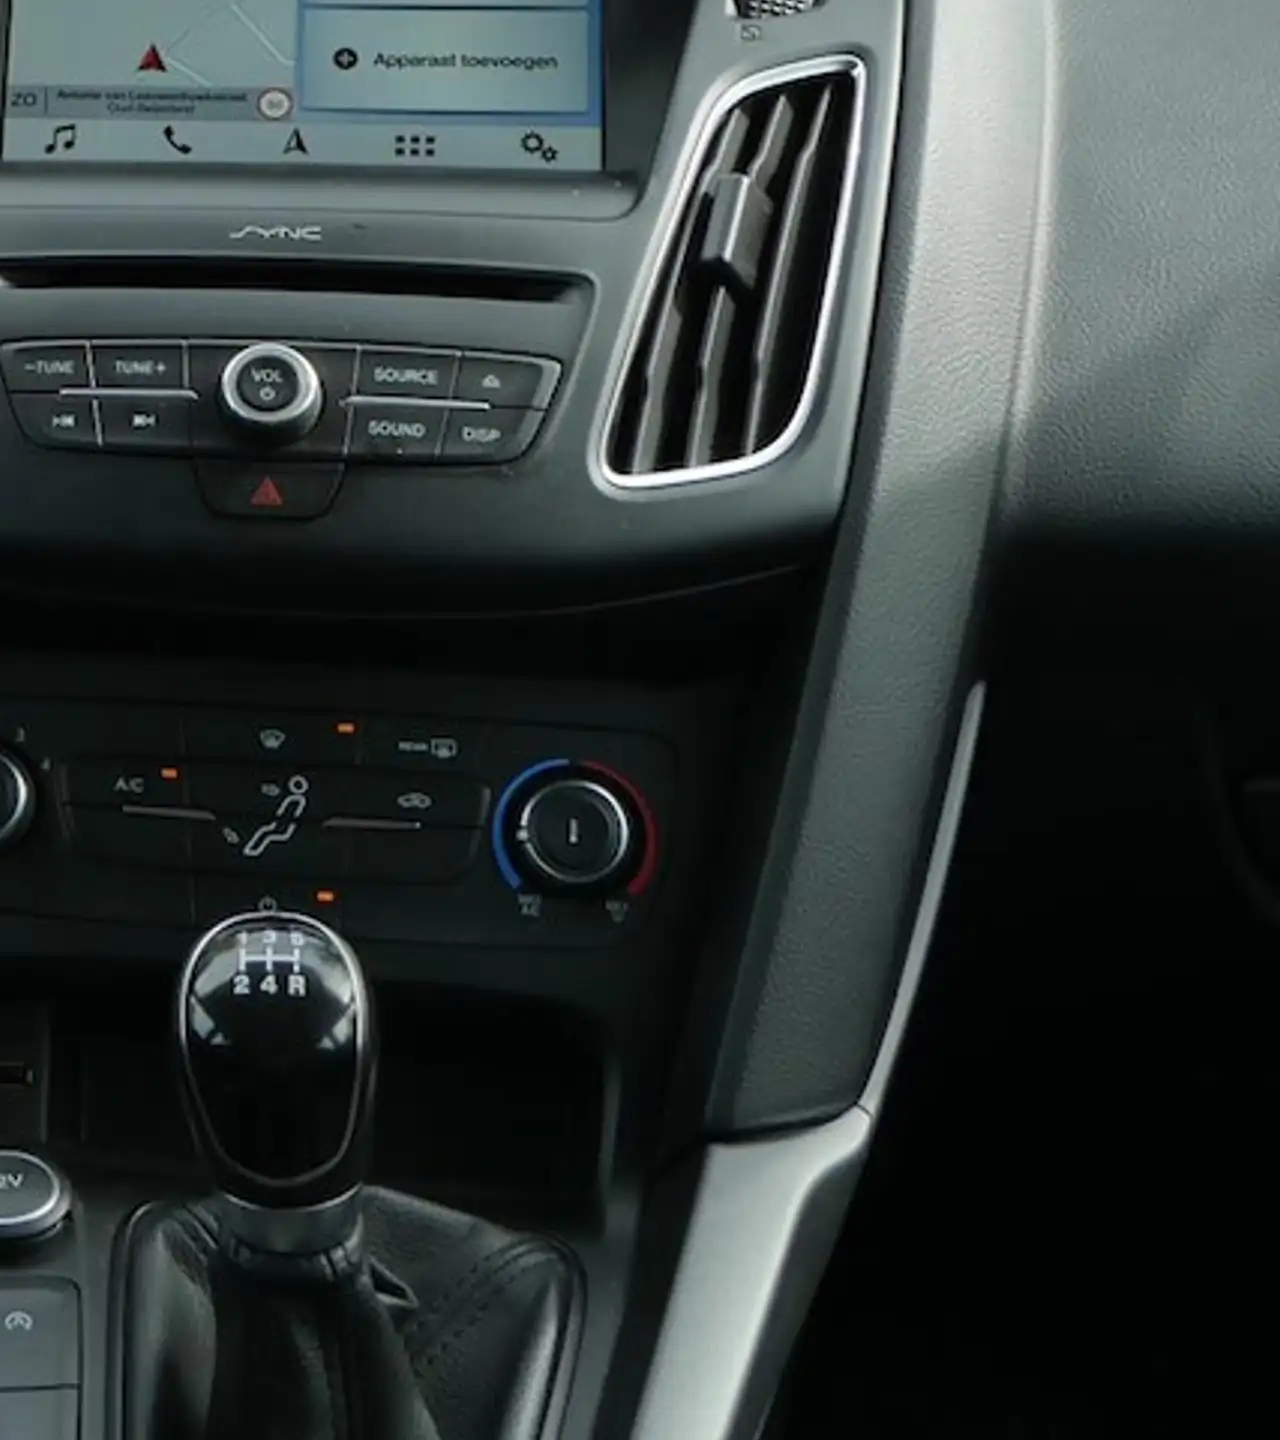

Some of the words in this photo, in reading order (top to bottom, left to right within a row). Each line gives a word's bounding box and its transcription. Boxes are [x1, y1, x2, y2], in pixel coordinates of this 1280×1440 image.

[374, 52, 456, 70] Apparaat
[461, 53, 558, 71] toevoegen
[229, 225, 322, 241] SYNC
[251, 367, 283, 383] VOL
[374, 366, 438, 385] SOURCE
[368, 420, 426, 438] SOUND
[233, 974, 250, 994] 2
[260, 974, 278, 995] 4
[287, 974, 306, 997] R
